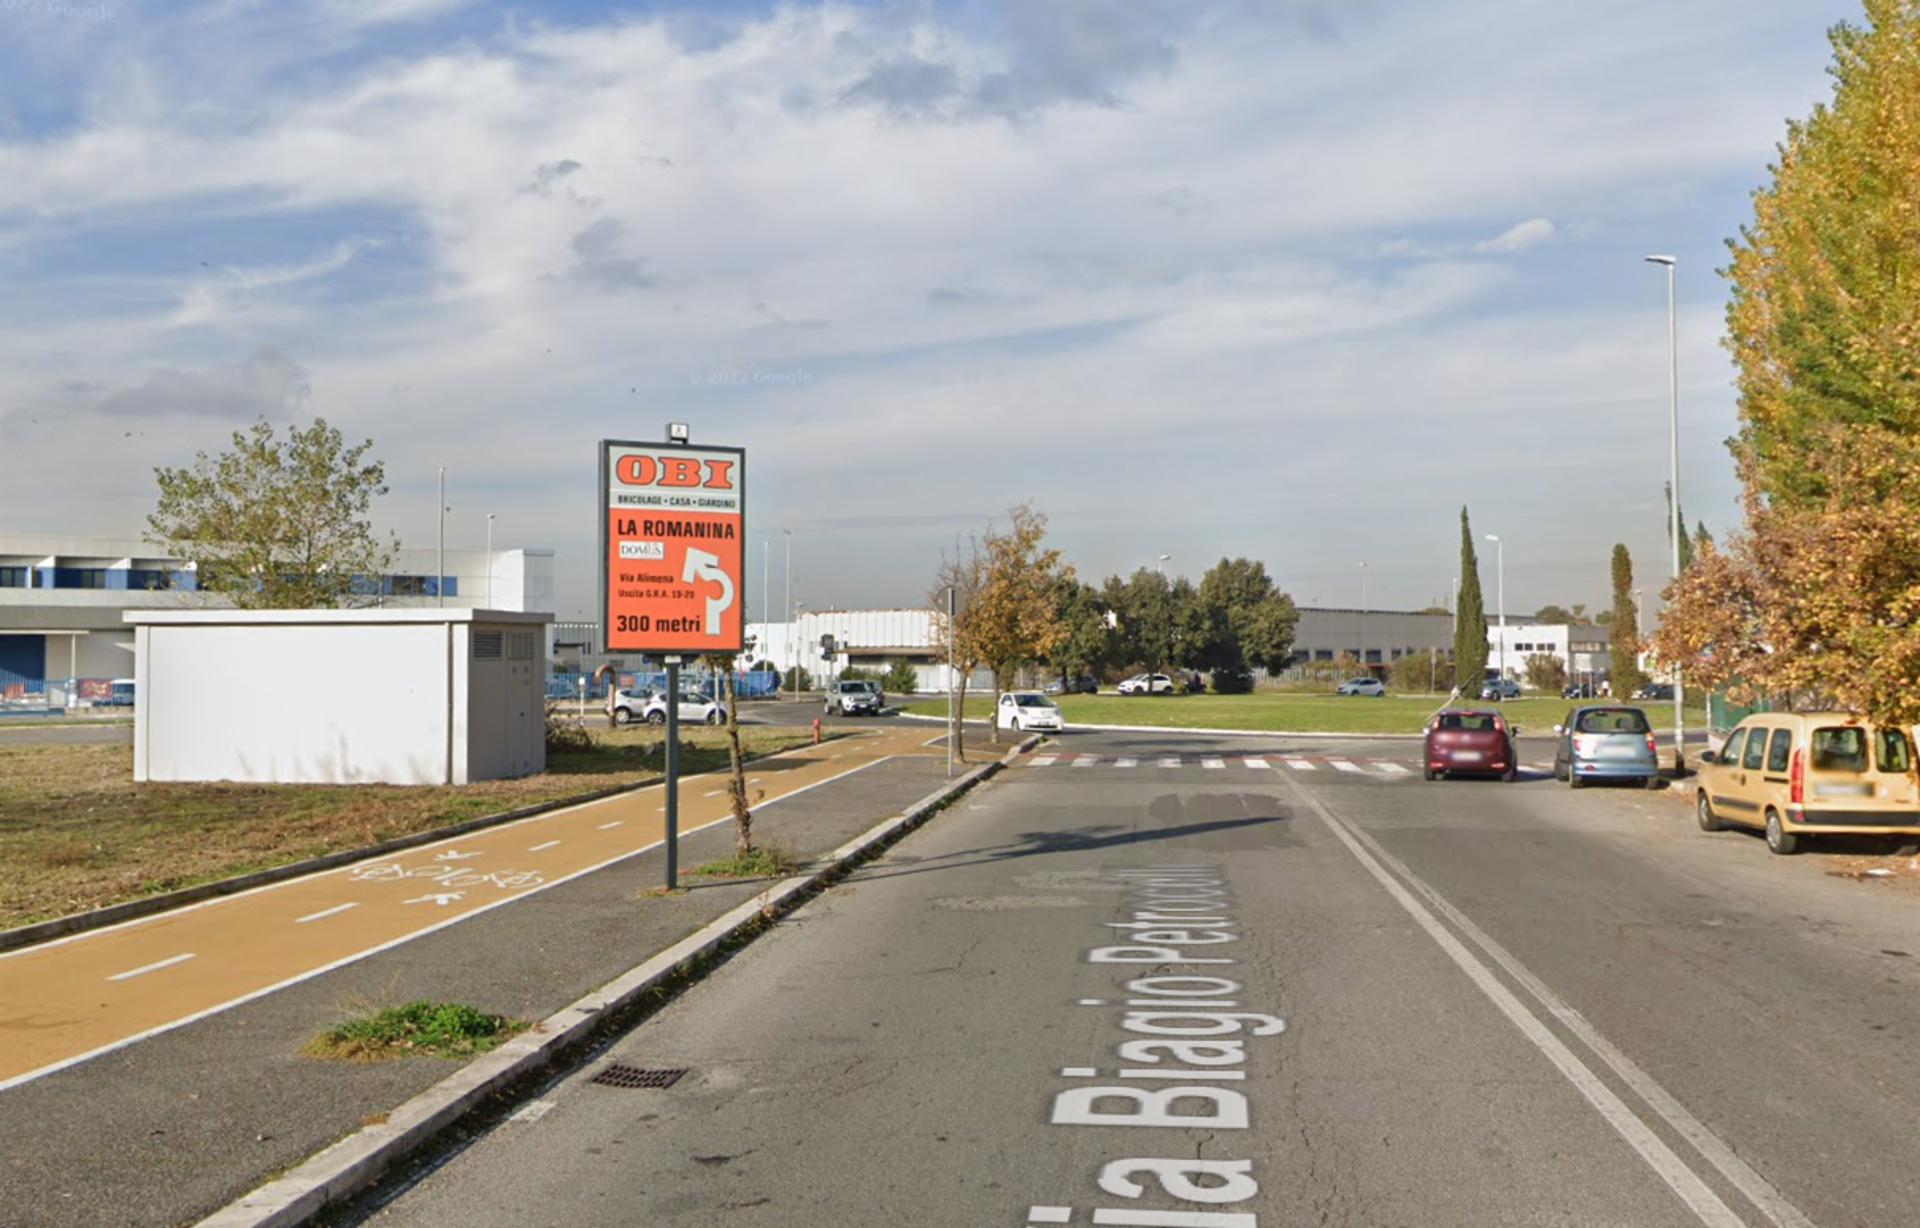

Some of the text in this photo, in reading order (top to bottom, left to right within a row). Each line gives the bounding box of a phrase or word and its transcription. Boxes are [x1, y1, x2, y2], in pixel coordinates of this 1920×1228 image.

[616, 454, 734, 489] OBI
[617, 494, 736, 508] BRICOLAGE CASA GIARDINO
[617, 518, 735, 539] LA ROMANINA
[620, 573, 674, 583] Via Alimena
[618, 588, 644, 598] Uscita
[645, 589, 670, 598] G.R.A.
[616, 615, 700, 632] 300 metri
